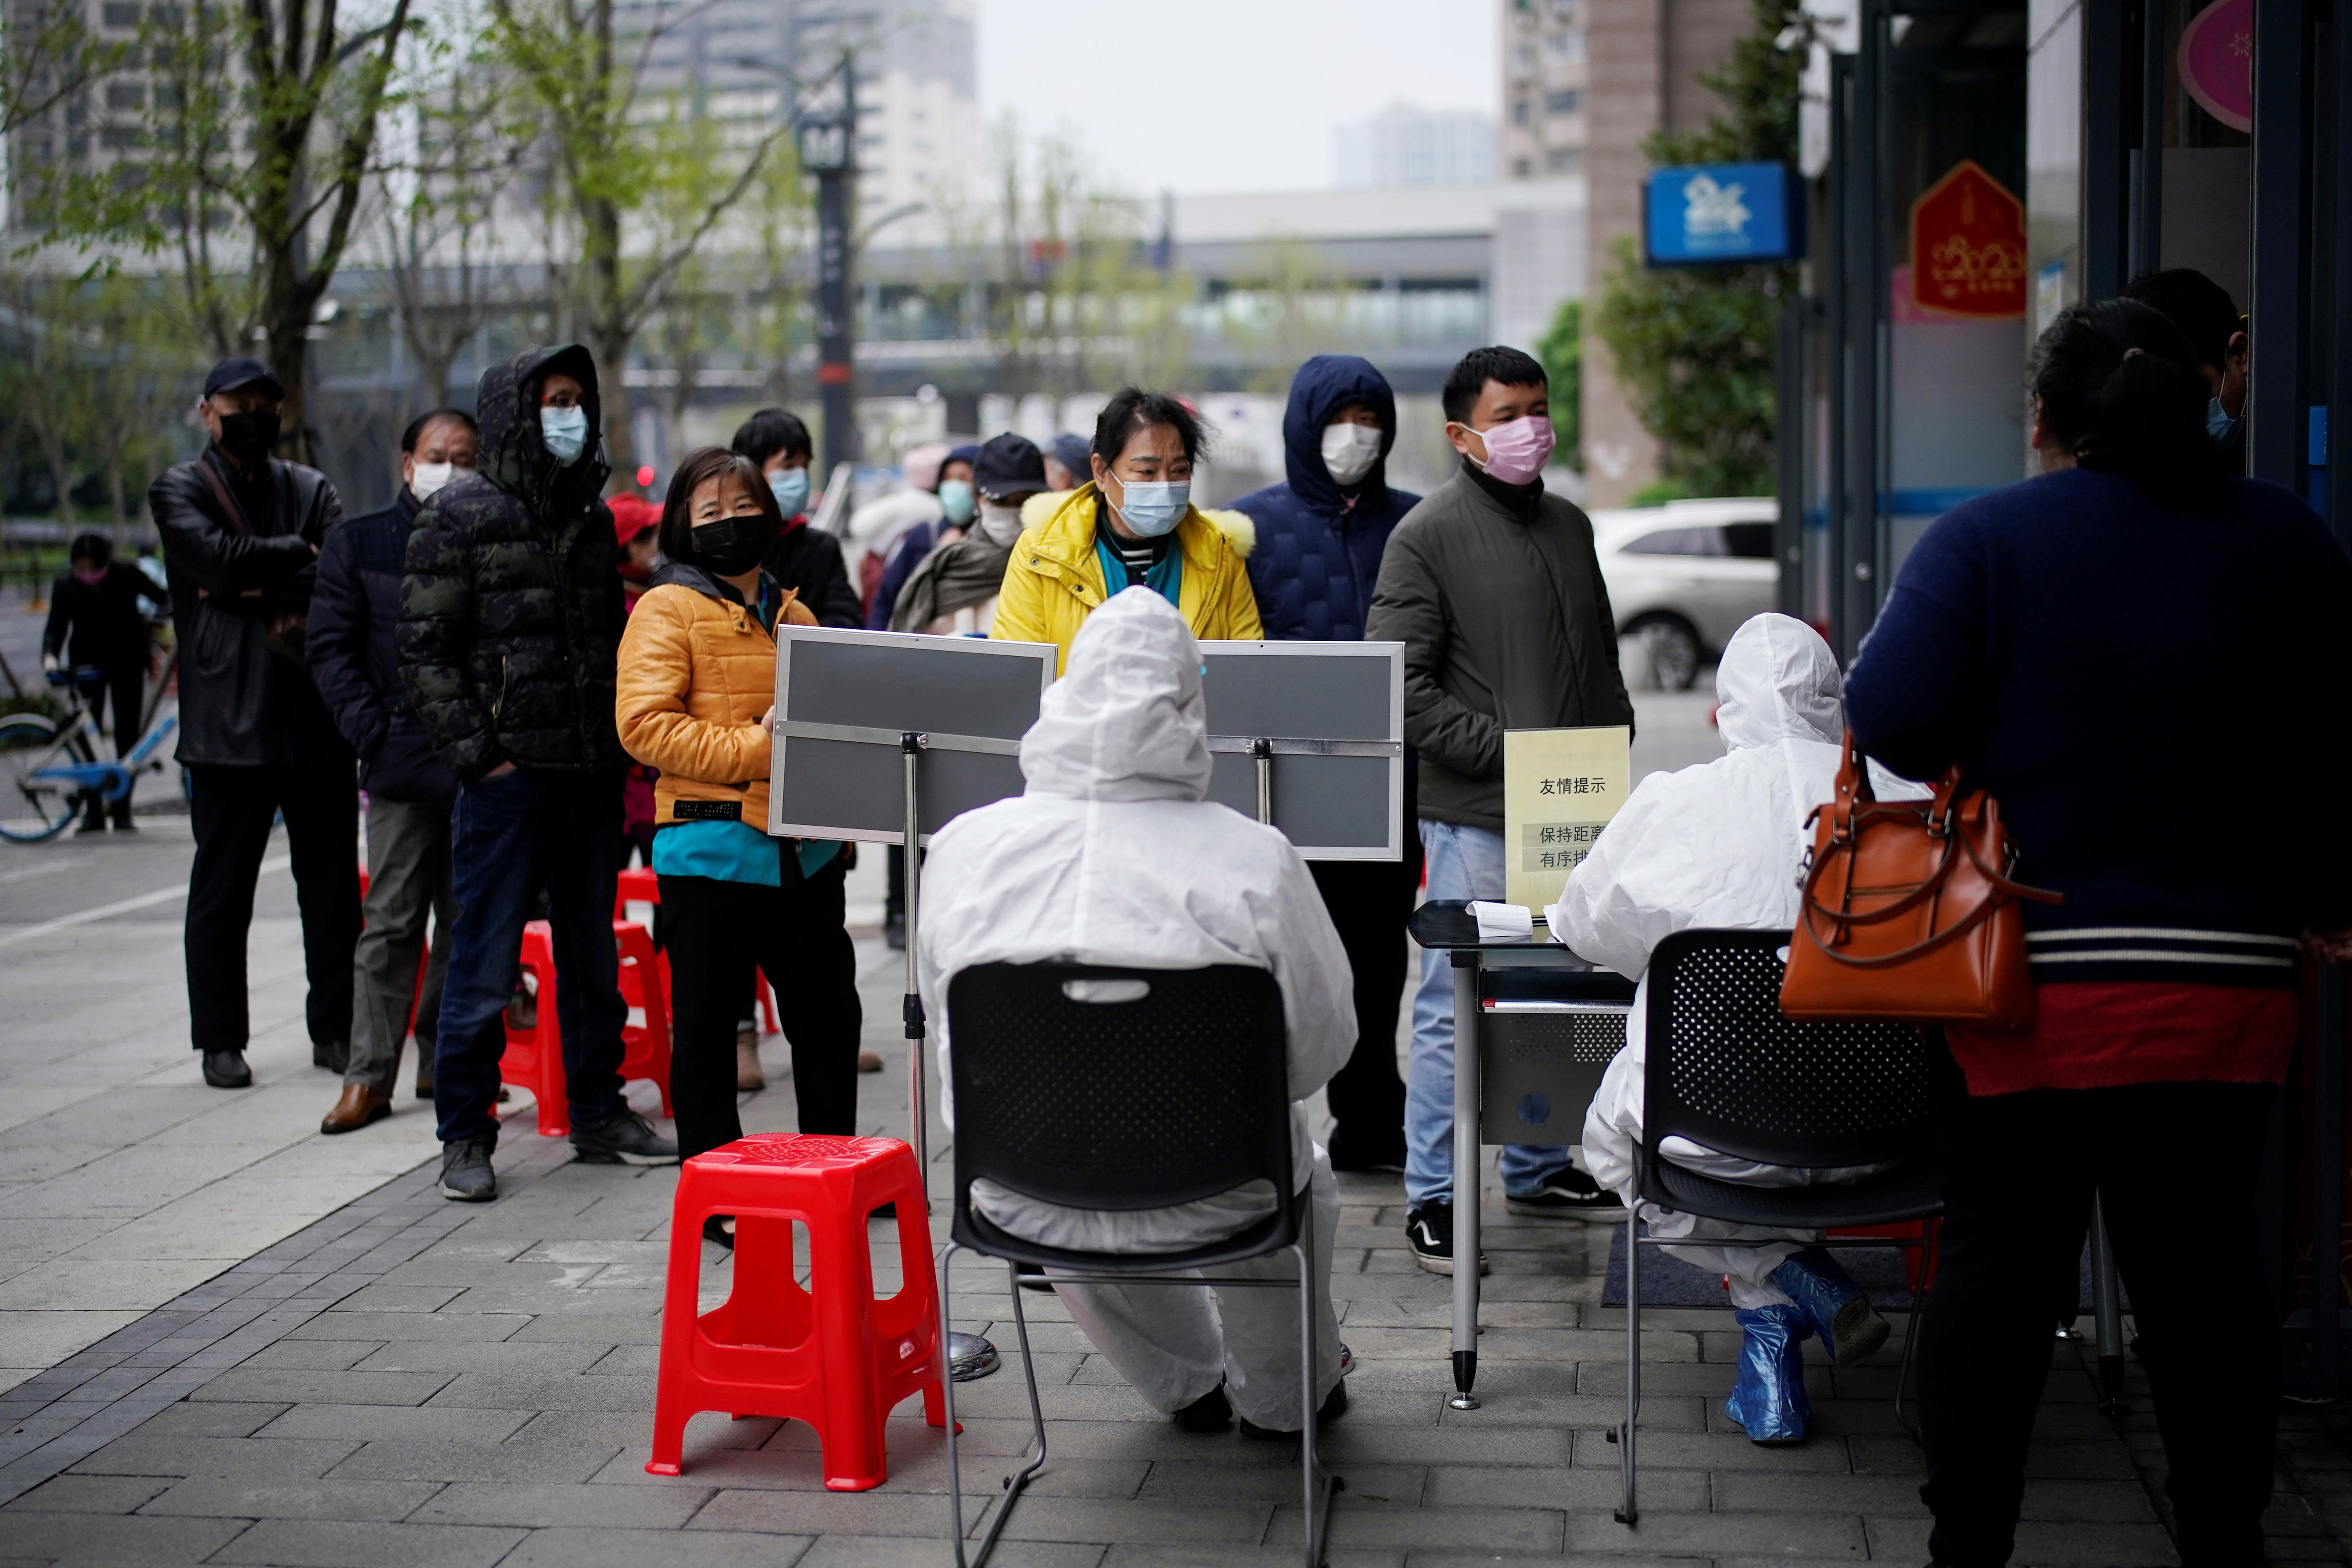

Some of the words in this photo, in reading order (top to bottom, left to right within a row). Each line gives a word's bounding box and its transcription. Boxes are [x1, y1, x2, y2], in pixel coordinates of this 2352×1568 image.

[1540, 778, 1605, 795] 友情提示
[1540, 825, 1605, 844] 保持距离
